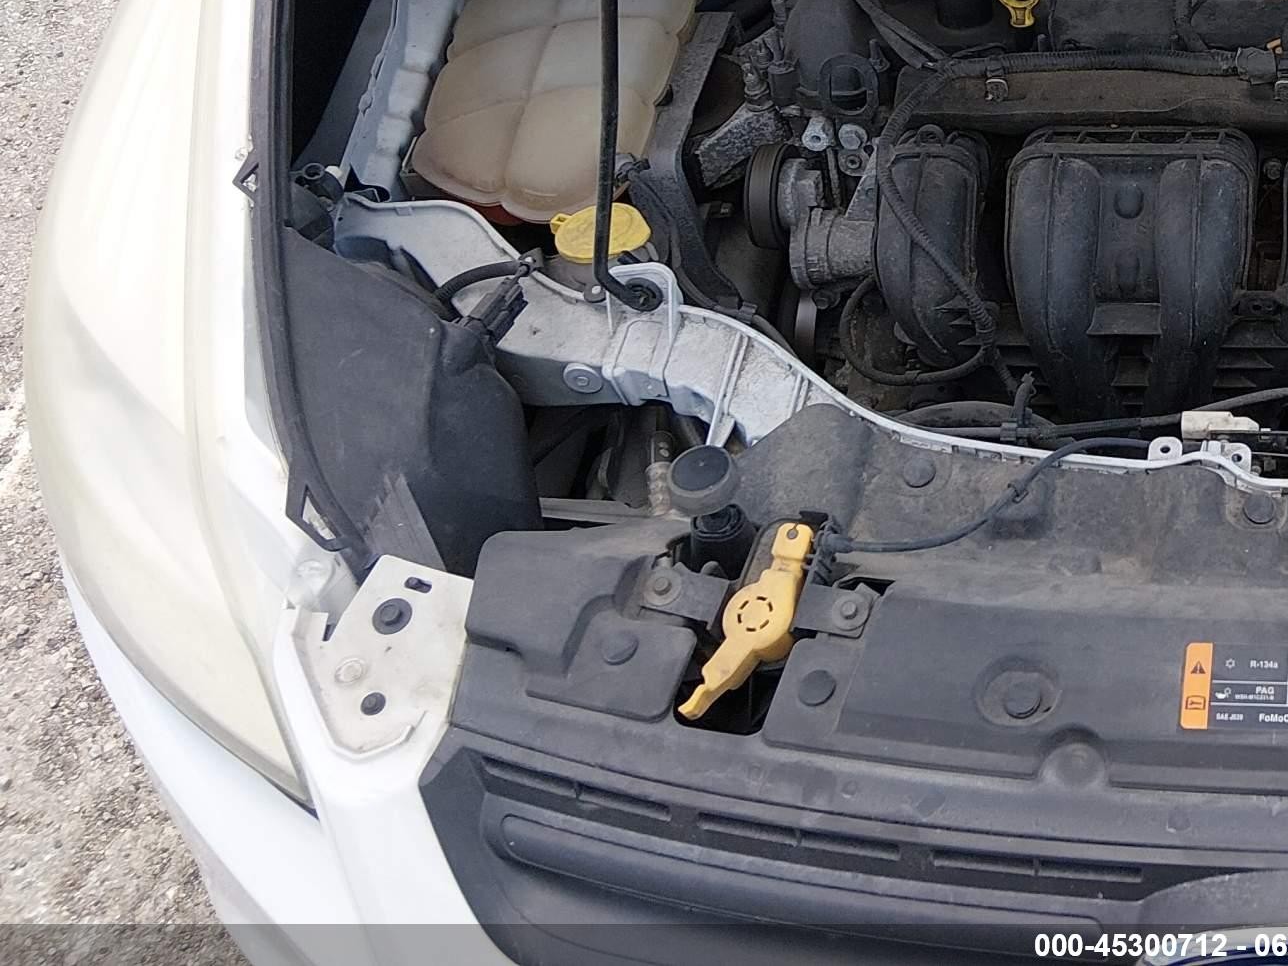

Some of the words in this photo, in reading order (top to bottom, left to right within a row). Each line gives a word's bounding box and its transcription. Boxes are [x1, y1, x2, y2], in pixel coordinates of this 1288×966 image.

[1249, 659, 1279, 669] R-134a
[1255, 686, 1275, 695] PAG
[1215, 712, 1229, 721] SAE
